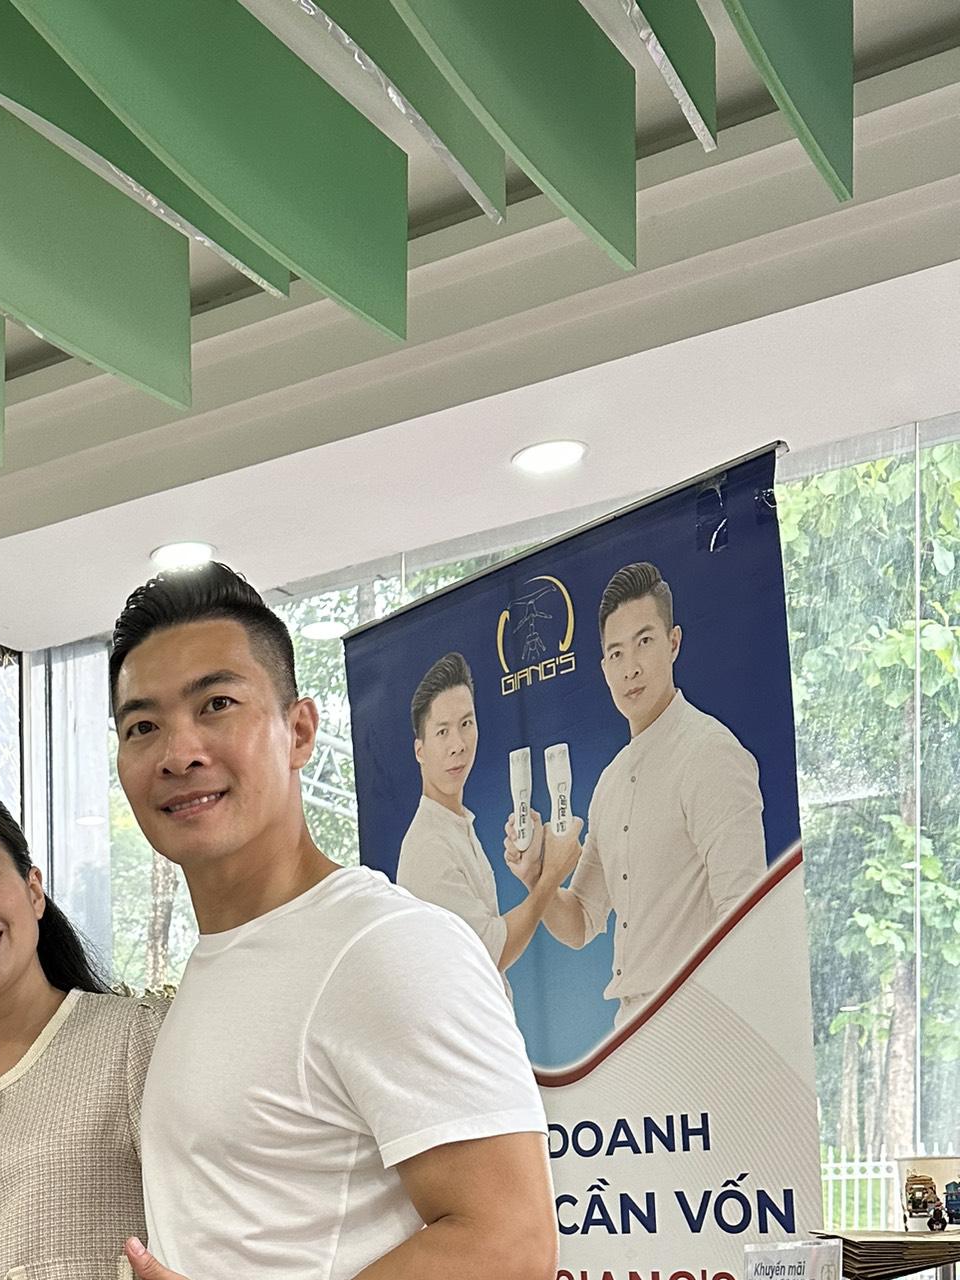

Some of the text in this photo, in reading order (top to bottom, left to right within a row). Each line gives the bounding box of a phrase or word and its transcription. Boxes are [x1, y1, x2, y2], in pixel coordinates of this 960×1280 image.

[548, 1112, 711, 1159] DOANH
[555, 1173, 796, 1235] CẦN VỐN
